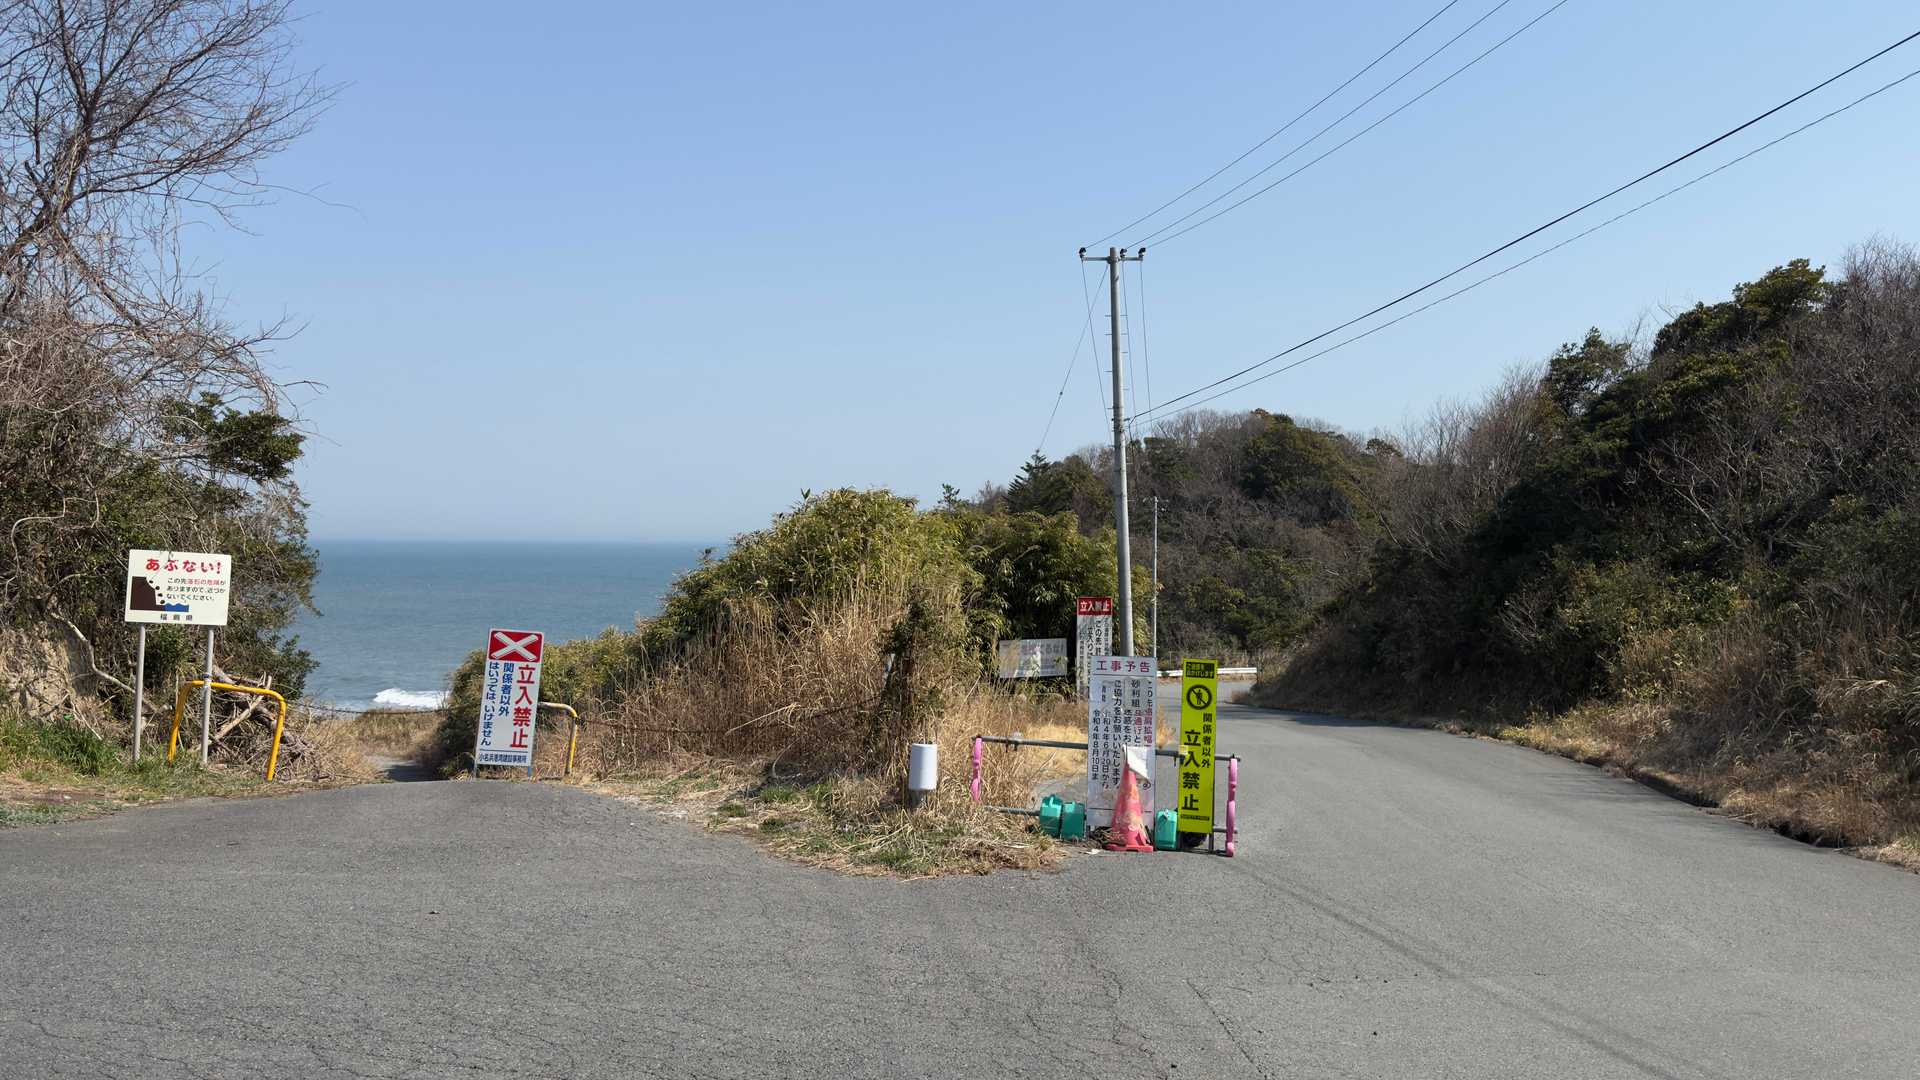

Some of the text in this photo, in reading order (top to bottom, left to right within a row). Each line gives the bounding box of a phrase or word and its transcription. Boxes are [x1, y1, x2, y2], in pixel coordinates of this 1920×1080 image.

[1080, 602, 1110, 612] 立入禁止
[498, 662, 514, 717] 関係者以外
[1096, 661, 1151, 673] 工事予告
[481, 661, 500, 746] はいっては、いけません
[510, 664, 536, 748] 立入禁止
[1202, 713, 1213, 768] 関係者以外
[1182, 729, 1201, 811] 立入禁止
